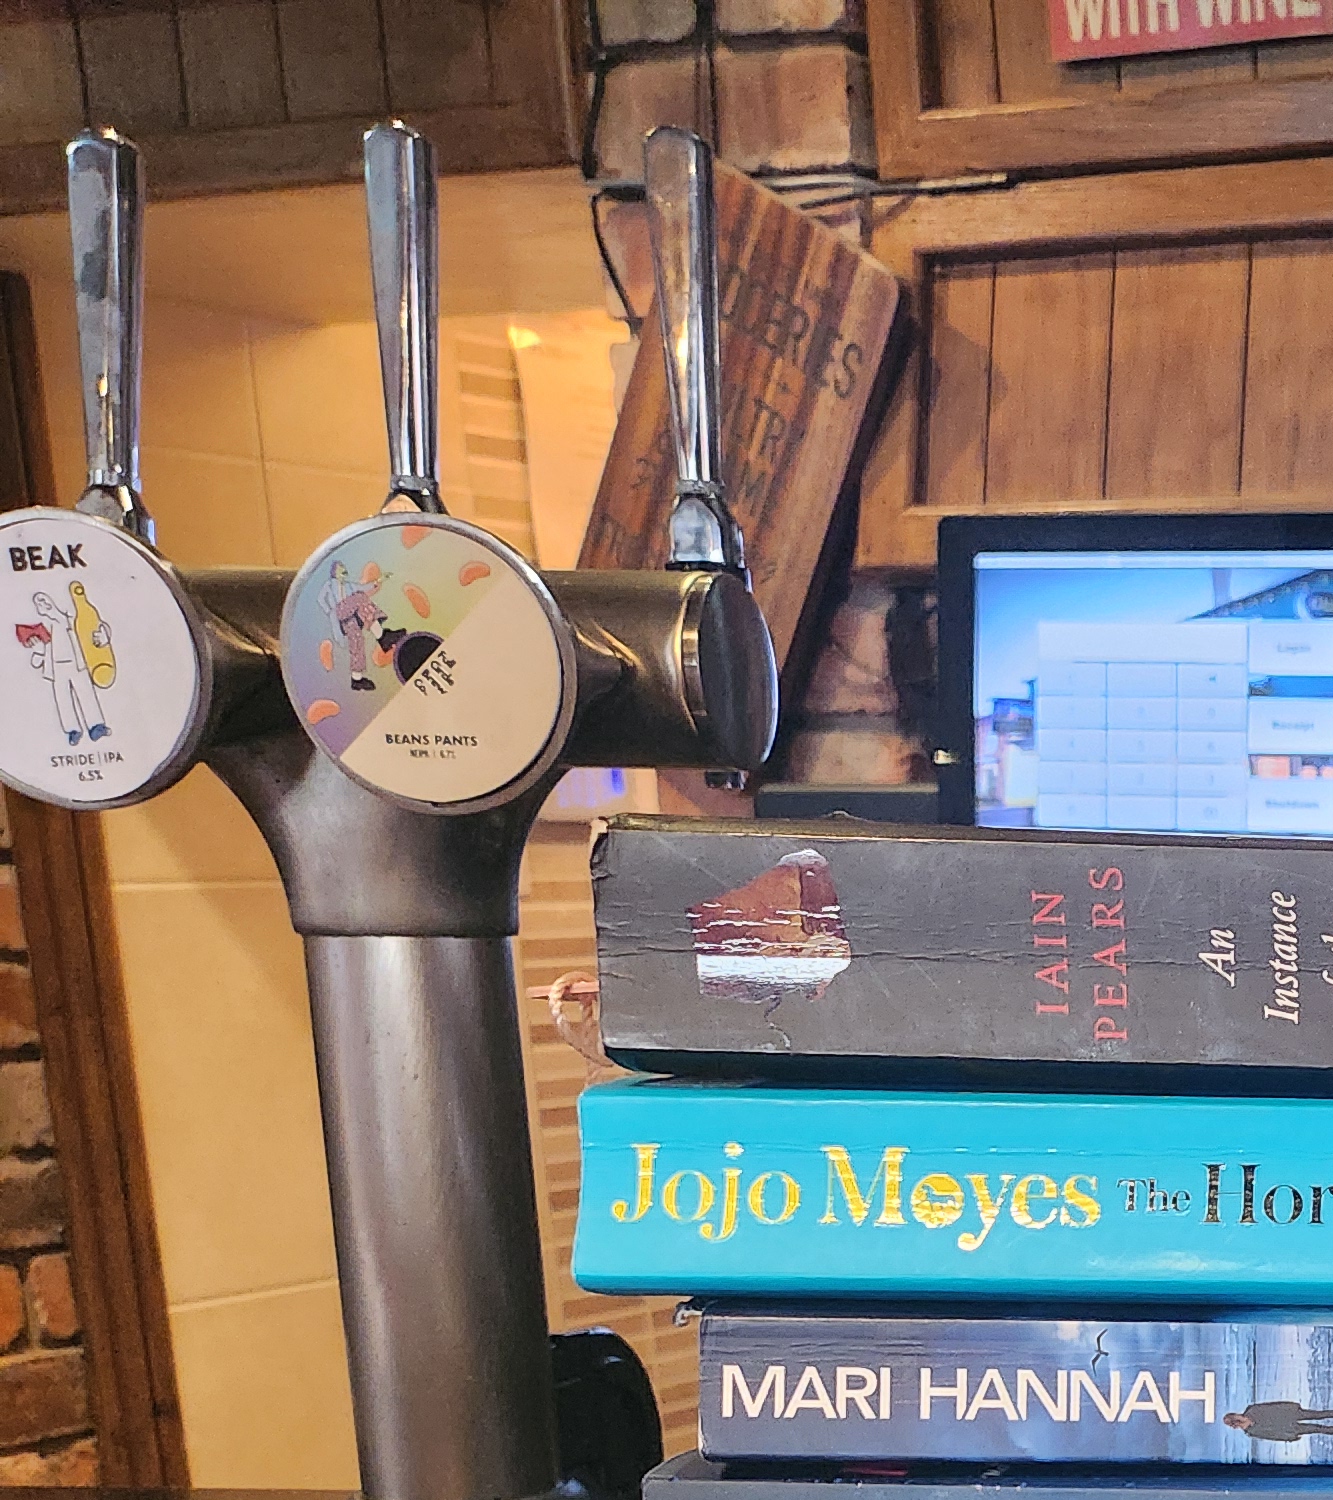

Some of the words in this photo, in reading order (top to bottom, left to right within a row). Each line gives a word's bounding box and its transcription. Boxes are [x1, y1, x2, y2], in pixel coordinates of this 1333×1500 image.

[9, 543, 88, 571] BEAK
[50, 753, 95, 768] STRIDE
[103, 751, 124, 764] IPA
[386, 733, 430, 745] BEANS
[434, 735, 478, 747] PANTS
[1031, 890, 1069, 1015] IAIN
[1089, 867, 1128, 1041] PEARS
[1199, 929, 1236, 986] An
[1264, 891, 1300, 1025] Instance
[611, 1142, 802, 1243] Jojo
[819, 1145, 1102, 1252] Moyes
[1116, 1177, 1192, 1216] The
[721, 1364, 892, 1420] MARI
[919, 1367, 1216, 1424] HANNAH
